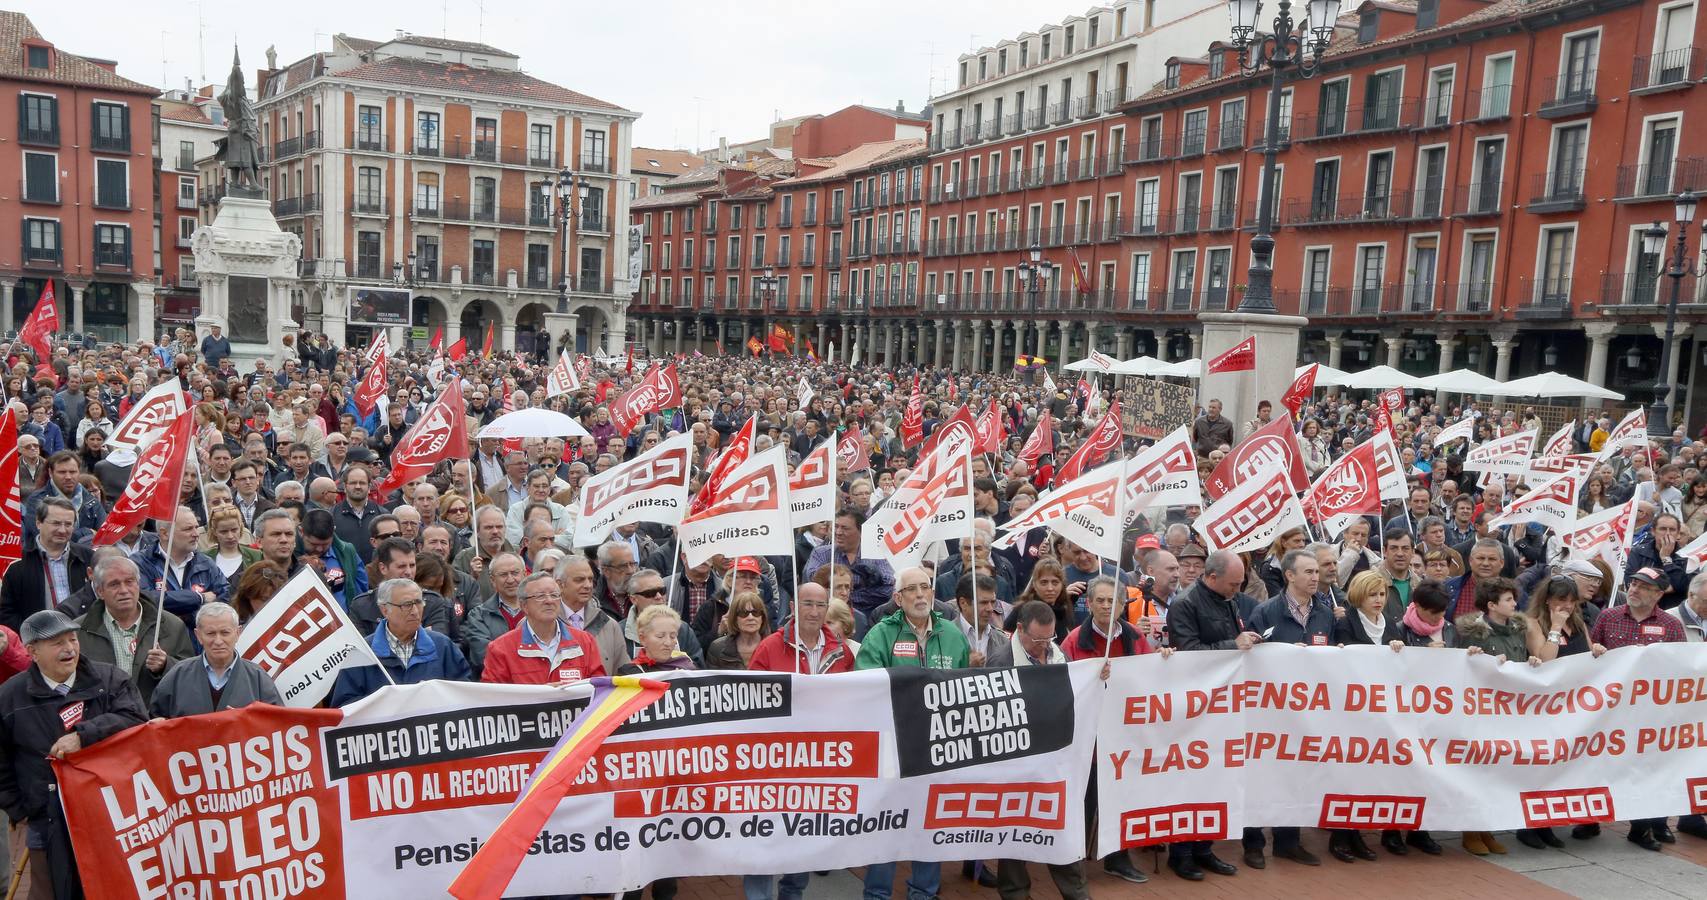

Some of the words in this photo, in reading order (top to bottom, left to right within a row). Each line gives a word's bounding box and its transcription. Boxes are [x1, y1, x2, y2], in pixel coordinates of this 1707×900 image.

[62, 702, 84, 720] CCOO
[654, 690, 686, 720] LAS
[688, 682, 783, 717] PENSIONES
[923, 668, 1023, 711] QUIEREN
[1123, 693, 1173, 725] EN
[1185, 680, 1331, 720] DEFENSA
[1344, 683, 1387, 713] DE
[1395, 685, 1454, 715] LOS
[1462, 681, 1624, 716] SERVICIOS
[929, 697, 1029, 741] ACABAR
[335, 731, 412, 769] EMPLEO
[417, 726, 440, 755] DE
[570, 755, 598, 787] OS
[603, 741, 729, 782] SERVICIOS
[735, 740, 854, 770] SOCIALES
[930, 740, 973, 767] CON
[978, 727, 1031, 758] TODO
[1109, 750, 1132, 780] Y
[1141, 739, 1210, 776] LAS
[1418, 738, 1438, 766] Y
[1445, 728, 1626, 766] EMPLEADOS
[100, 767, 167, 833] LA
[167, 724, 313, 797] CRISIS
[367, 771, 415, 812] NO
[421, 771, 445, 801] AL
[449, 763, 530, 799] RECORTE
[639, 789, 656, 815] Y
[660, 786, 707, 812] LAS
[713, 785, 852, 812] PENSIONES
[116, 802, 192, 854] TERMINA
[194, 783, 266, 815] CUANDO
[268, 771, 314, 798] HAYA
[935, 791, 1059, 820] CCOO
[1125, 809, 1222, 842] CCOO
[1326, 800, 1420, 824] CCOO
[1525, 794, 1608, 821] CCOO
[127, 796, 321, 900] EMPLEO
[394, 827, 586, 870] Pensistas
[594, 826, 631, 851] de
[638, 815, 731, 849] CC.OO.
[739, 814, 775, 837] de
[781, 808, 910, 837] Valladolid
[932, 829, 994, 846] Castilla
[997, 830, 1008, 846] y
[1012, 827, 1055, 847] León
[219, 852, 326, 900] TODOS
